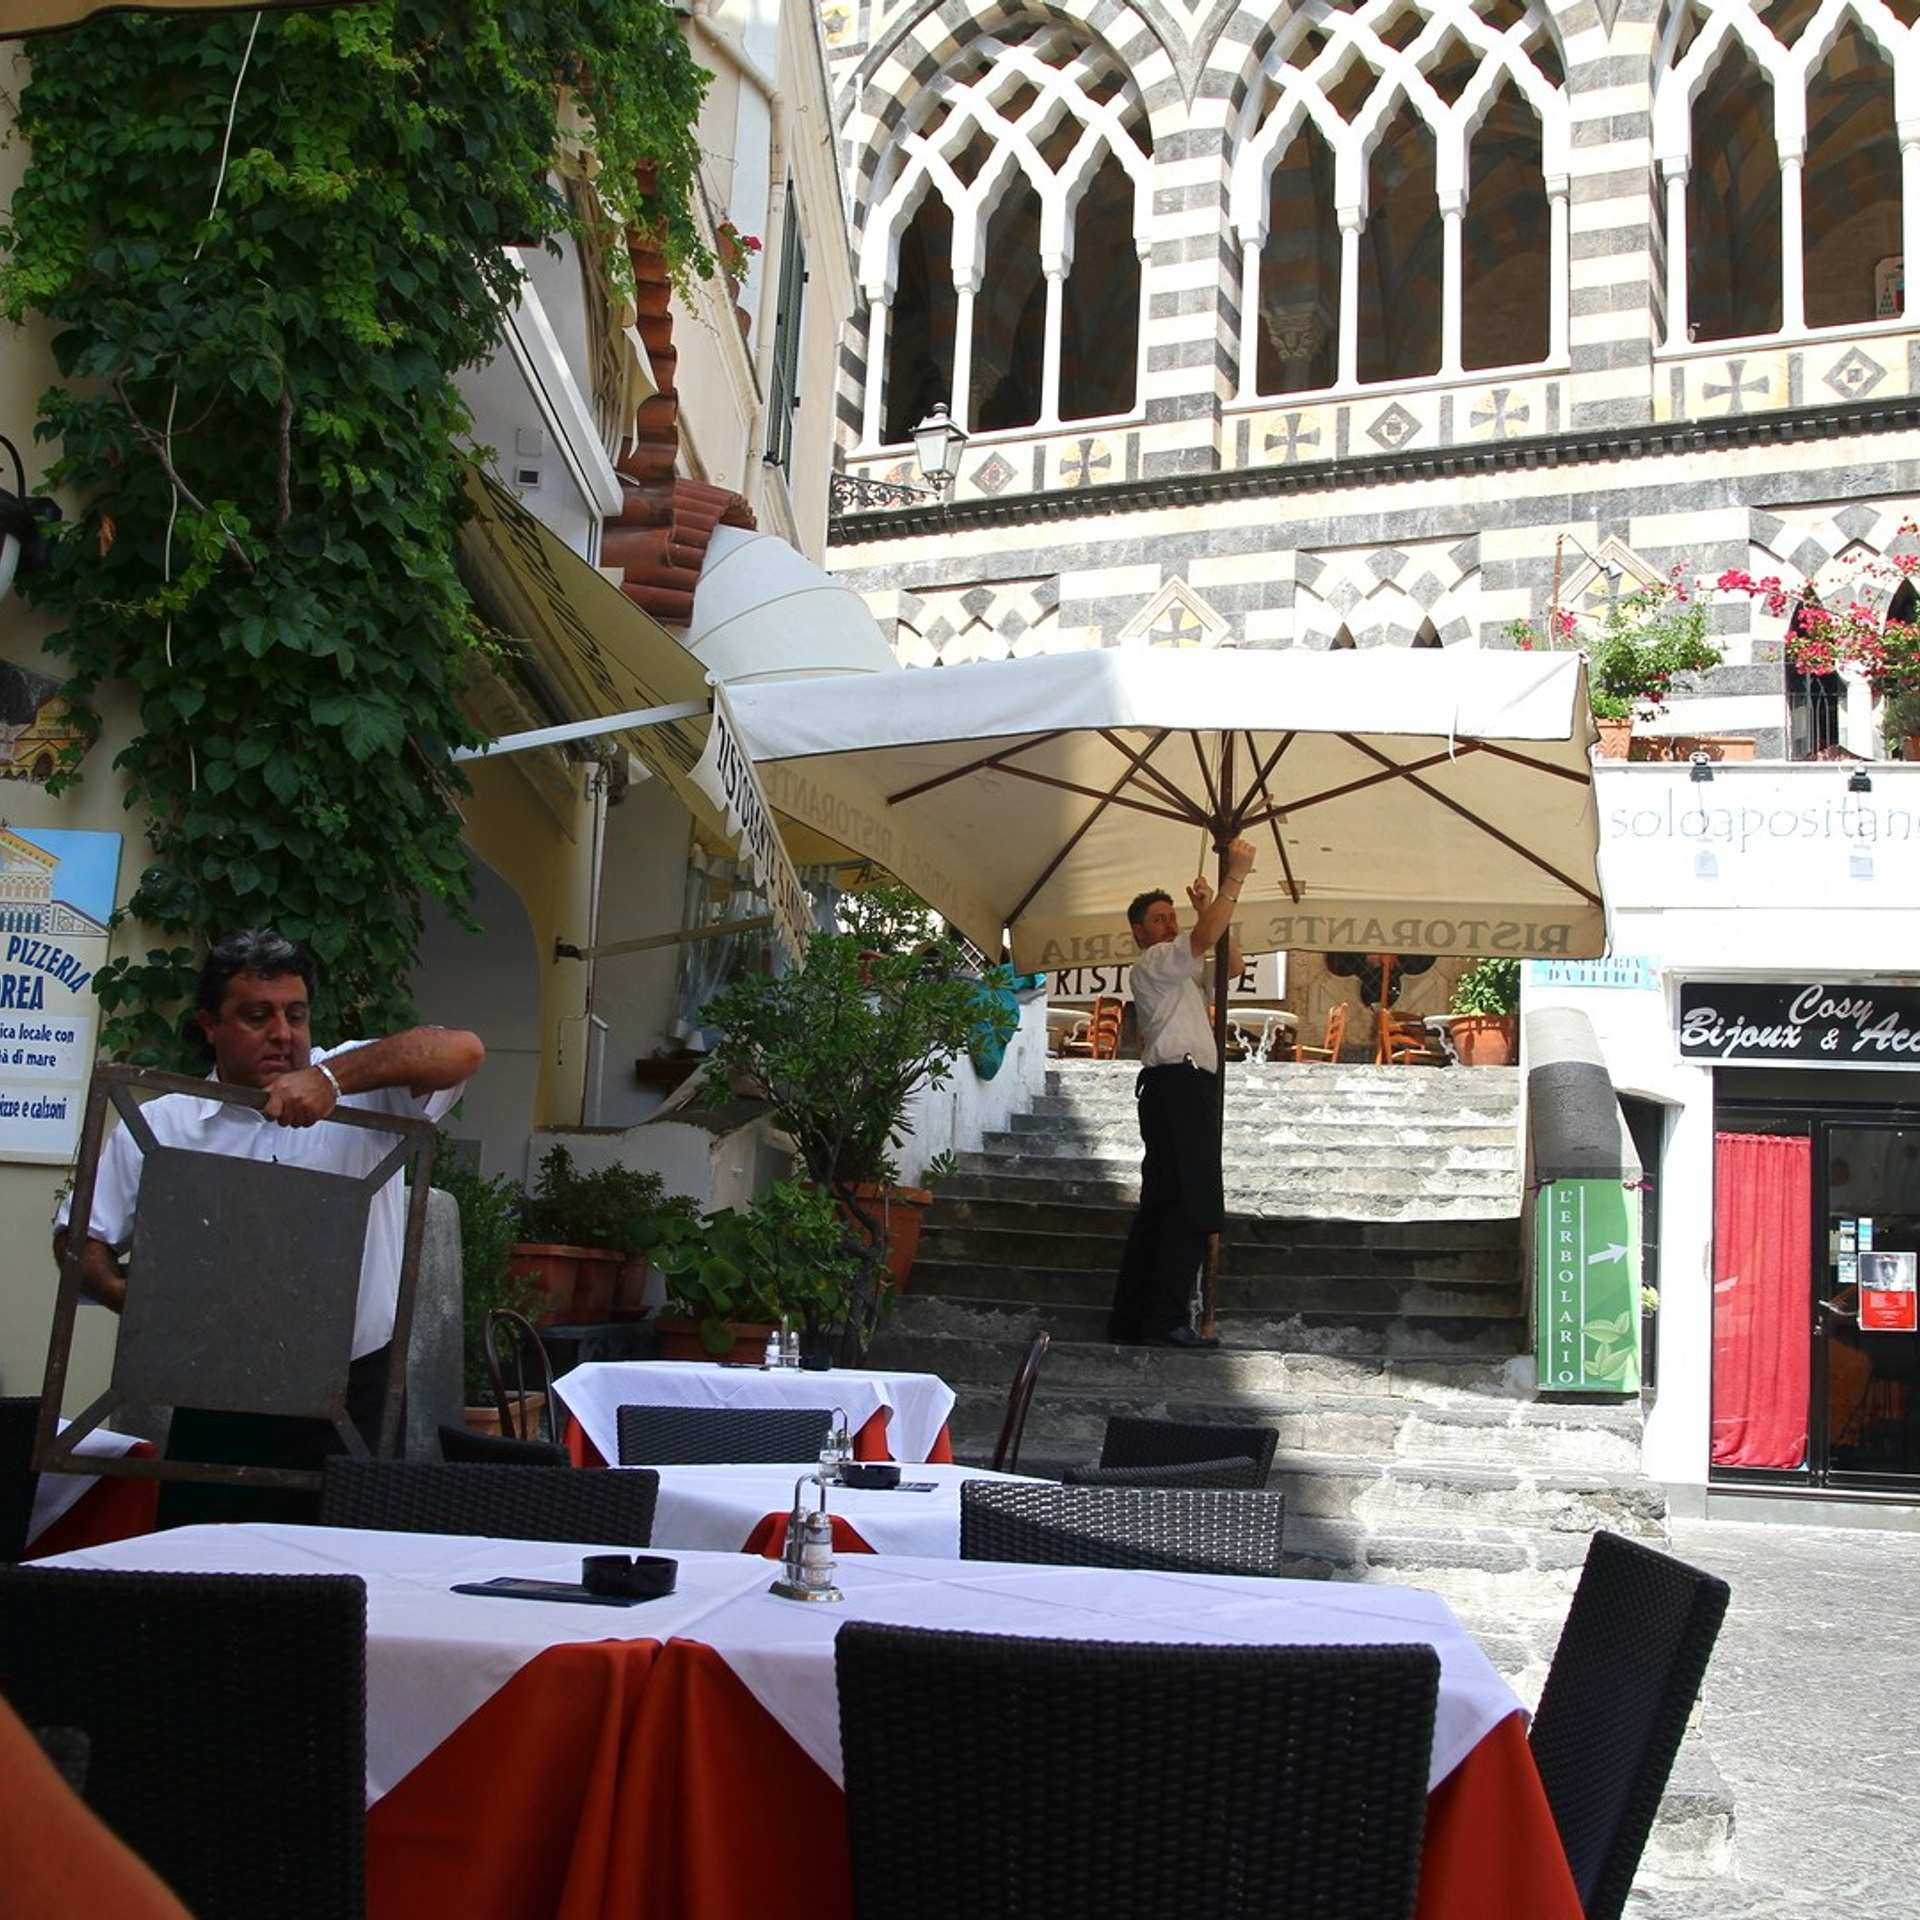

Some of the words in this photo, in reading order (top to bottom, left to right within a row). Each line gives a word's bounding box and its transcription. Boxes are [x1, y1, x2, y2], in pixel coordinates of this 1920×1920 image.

[1611, 787, 1920, 853] soloapositan
[6, 935, 91, 993] PIZZERIA
[0, 973, 44, 1010] REA
[1788, 984, 1873, 1030] Cosy
[18, 1023, 53, 1041] locale
[55, 1030, 75, 1044] con
[1680, 1007, 1802, 1058] Bijoux
[1820, 1028, 1840, 1051] &
[12, 1049, 24, 1064] di
[26, 1053, 57, 1067] mare
[21, 1101, 30, 1117] e
[31, 1095, 67, 1119] calzoni
